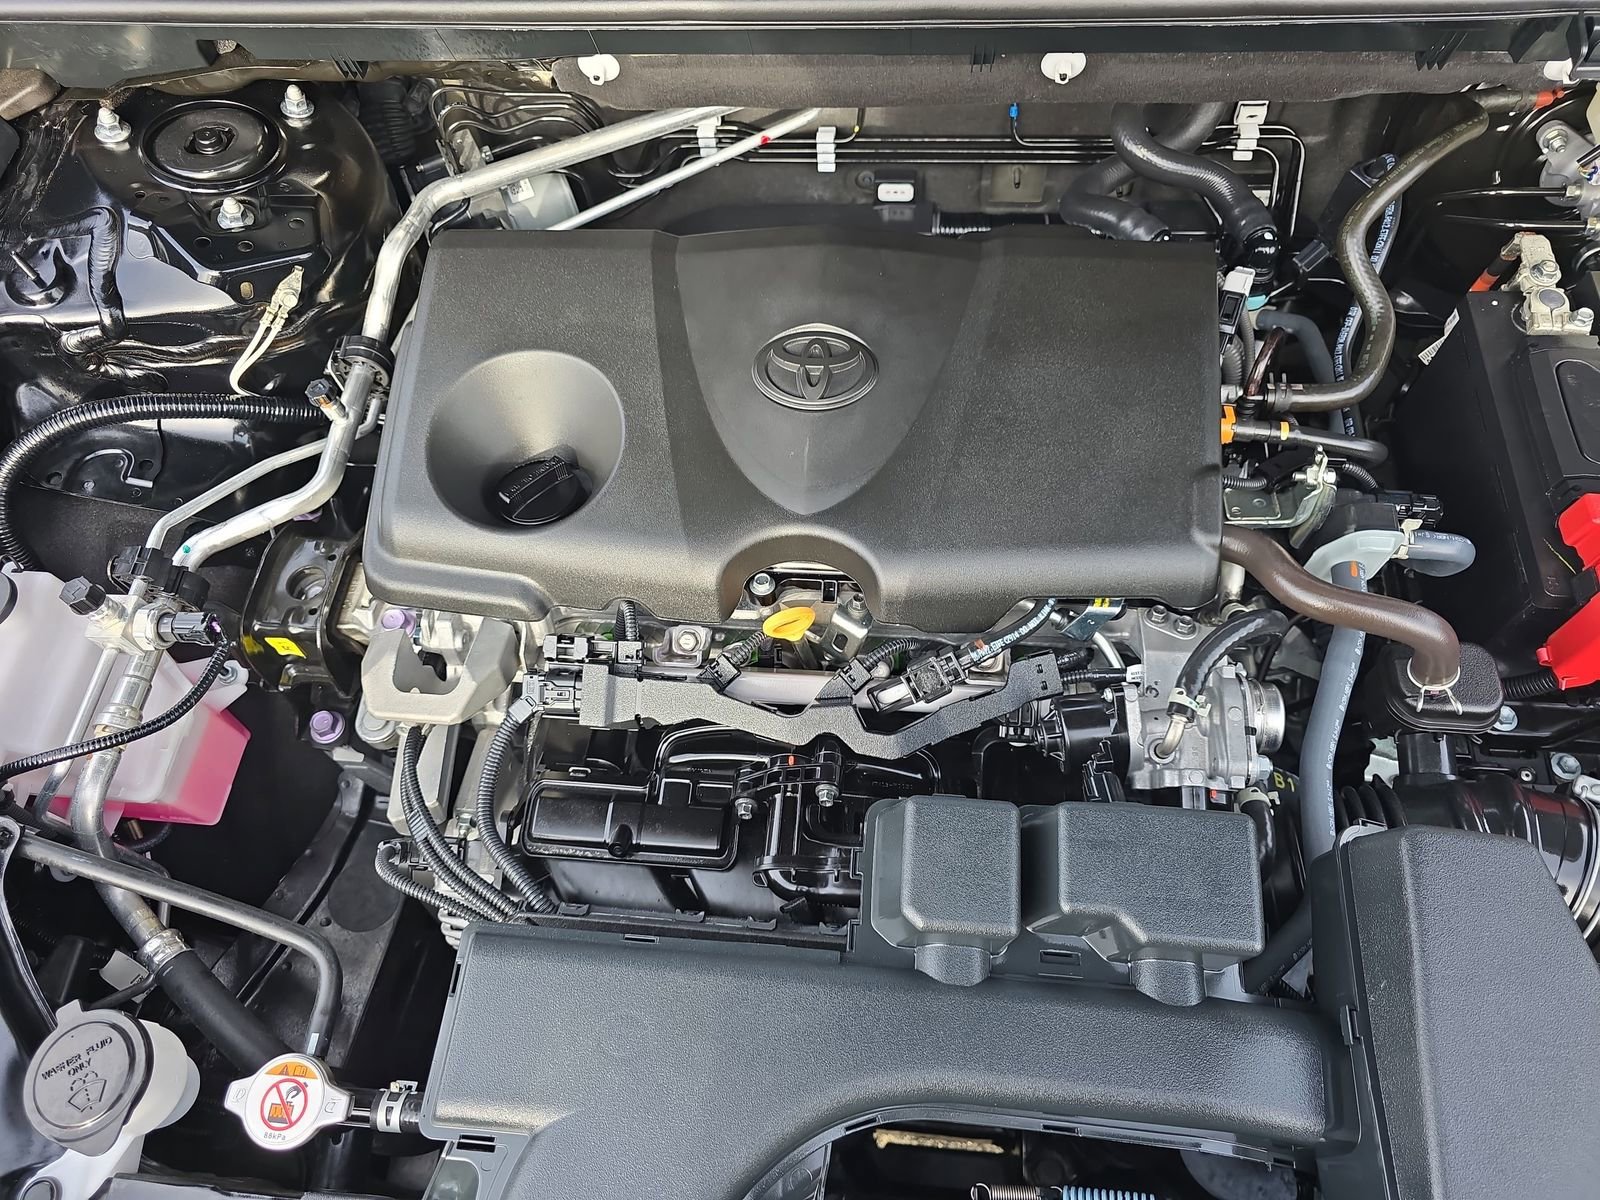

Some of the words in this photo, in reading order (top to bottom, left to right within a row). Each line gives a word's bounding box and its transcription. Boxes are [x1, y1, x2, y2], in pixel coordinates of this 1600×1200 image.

[1273, 771, 1295, 793] B1
[41, 1053, 82, 1080] WASHER
[86, 1036, 113, 1056] FLUID
[67, 1057, 92, 1076] ONLY
